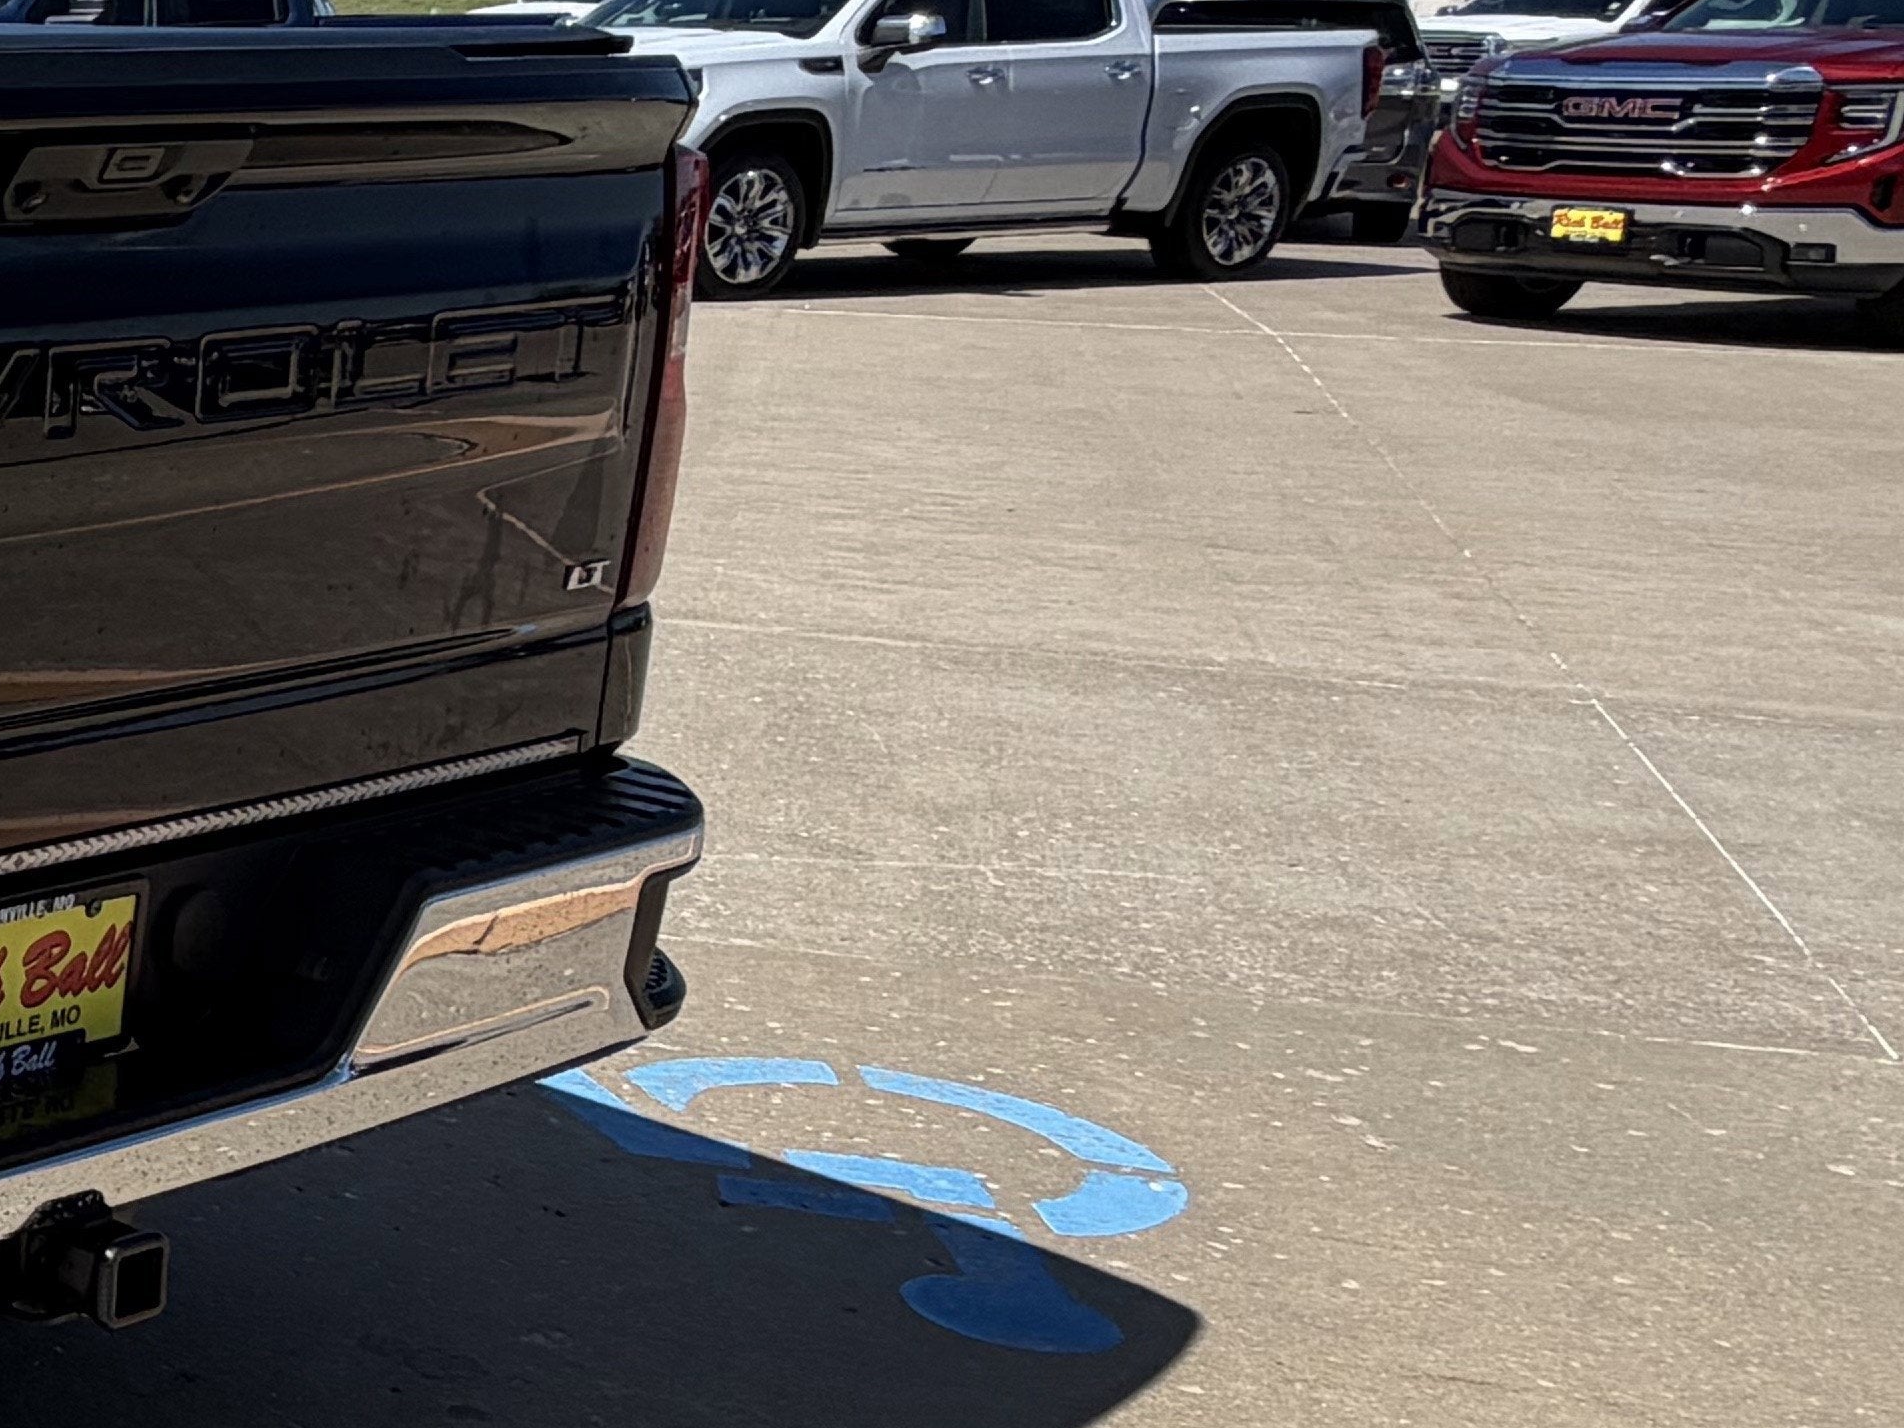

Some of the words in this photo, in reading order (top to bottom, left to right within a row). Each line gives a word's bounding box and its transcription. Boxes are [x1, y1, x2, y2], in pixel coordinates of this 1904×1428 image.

[1562, 96, 1683, 120] GMC
[566, 560, 612, 591] LT
[52, 893, 76, 913] MO
[20, 921, 133, 1008] Ball
[50, 1004, 82, 1029] MO
[10, 1040, 58, 1077] Ball
